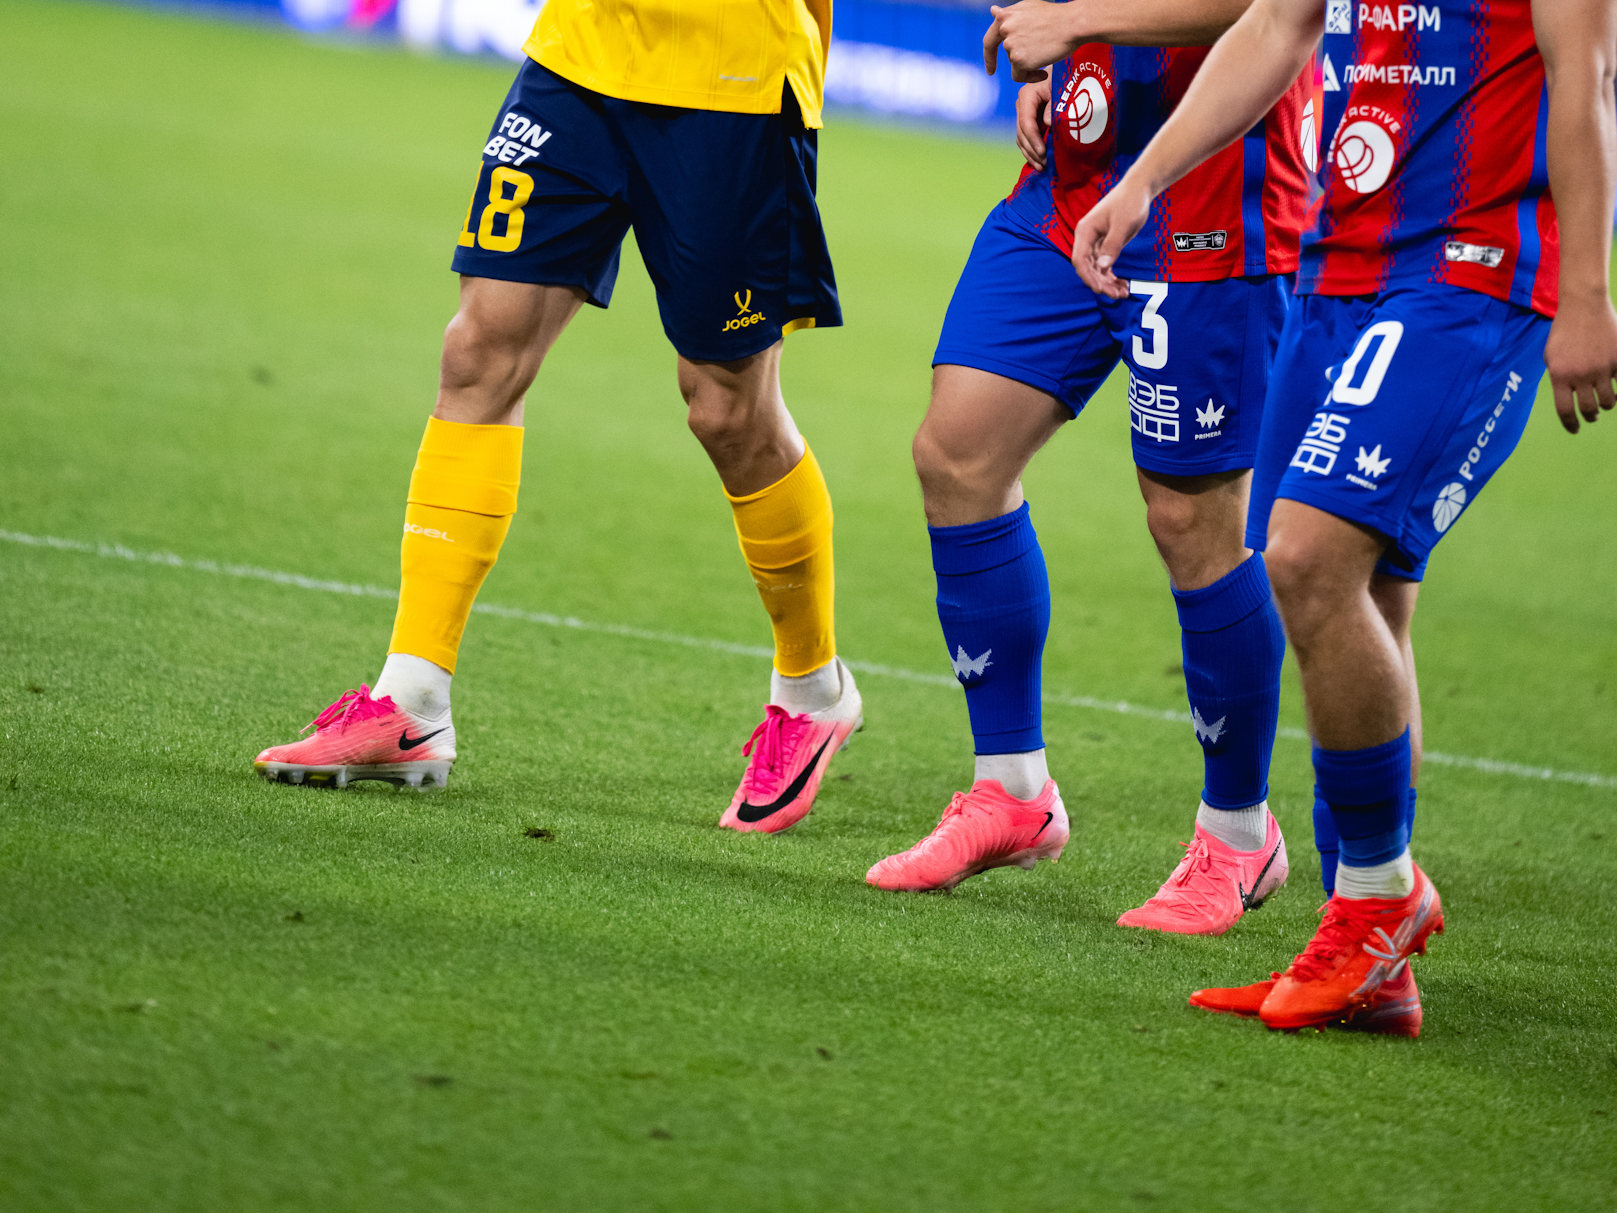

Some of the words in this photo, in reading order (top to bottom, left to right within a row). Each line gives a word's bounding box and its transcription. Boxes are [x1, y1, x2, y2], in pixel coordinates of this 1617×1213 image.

[1359, 3, 1441, 32] Р-ФАРМ
[498, 112, 552, 148] FON
[482, 136, 540, 167] BET
[1129, 280, 1169, 370] 3
[1323, 321, 1404, 406] 0
[1128, 371, 1180, 411] ВЭБ
[1305, 413, 1351, 444] ЭБ
[1459, 370, 1522, 481] РОССЕТИ
